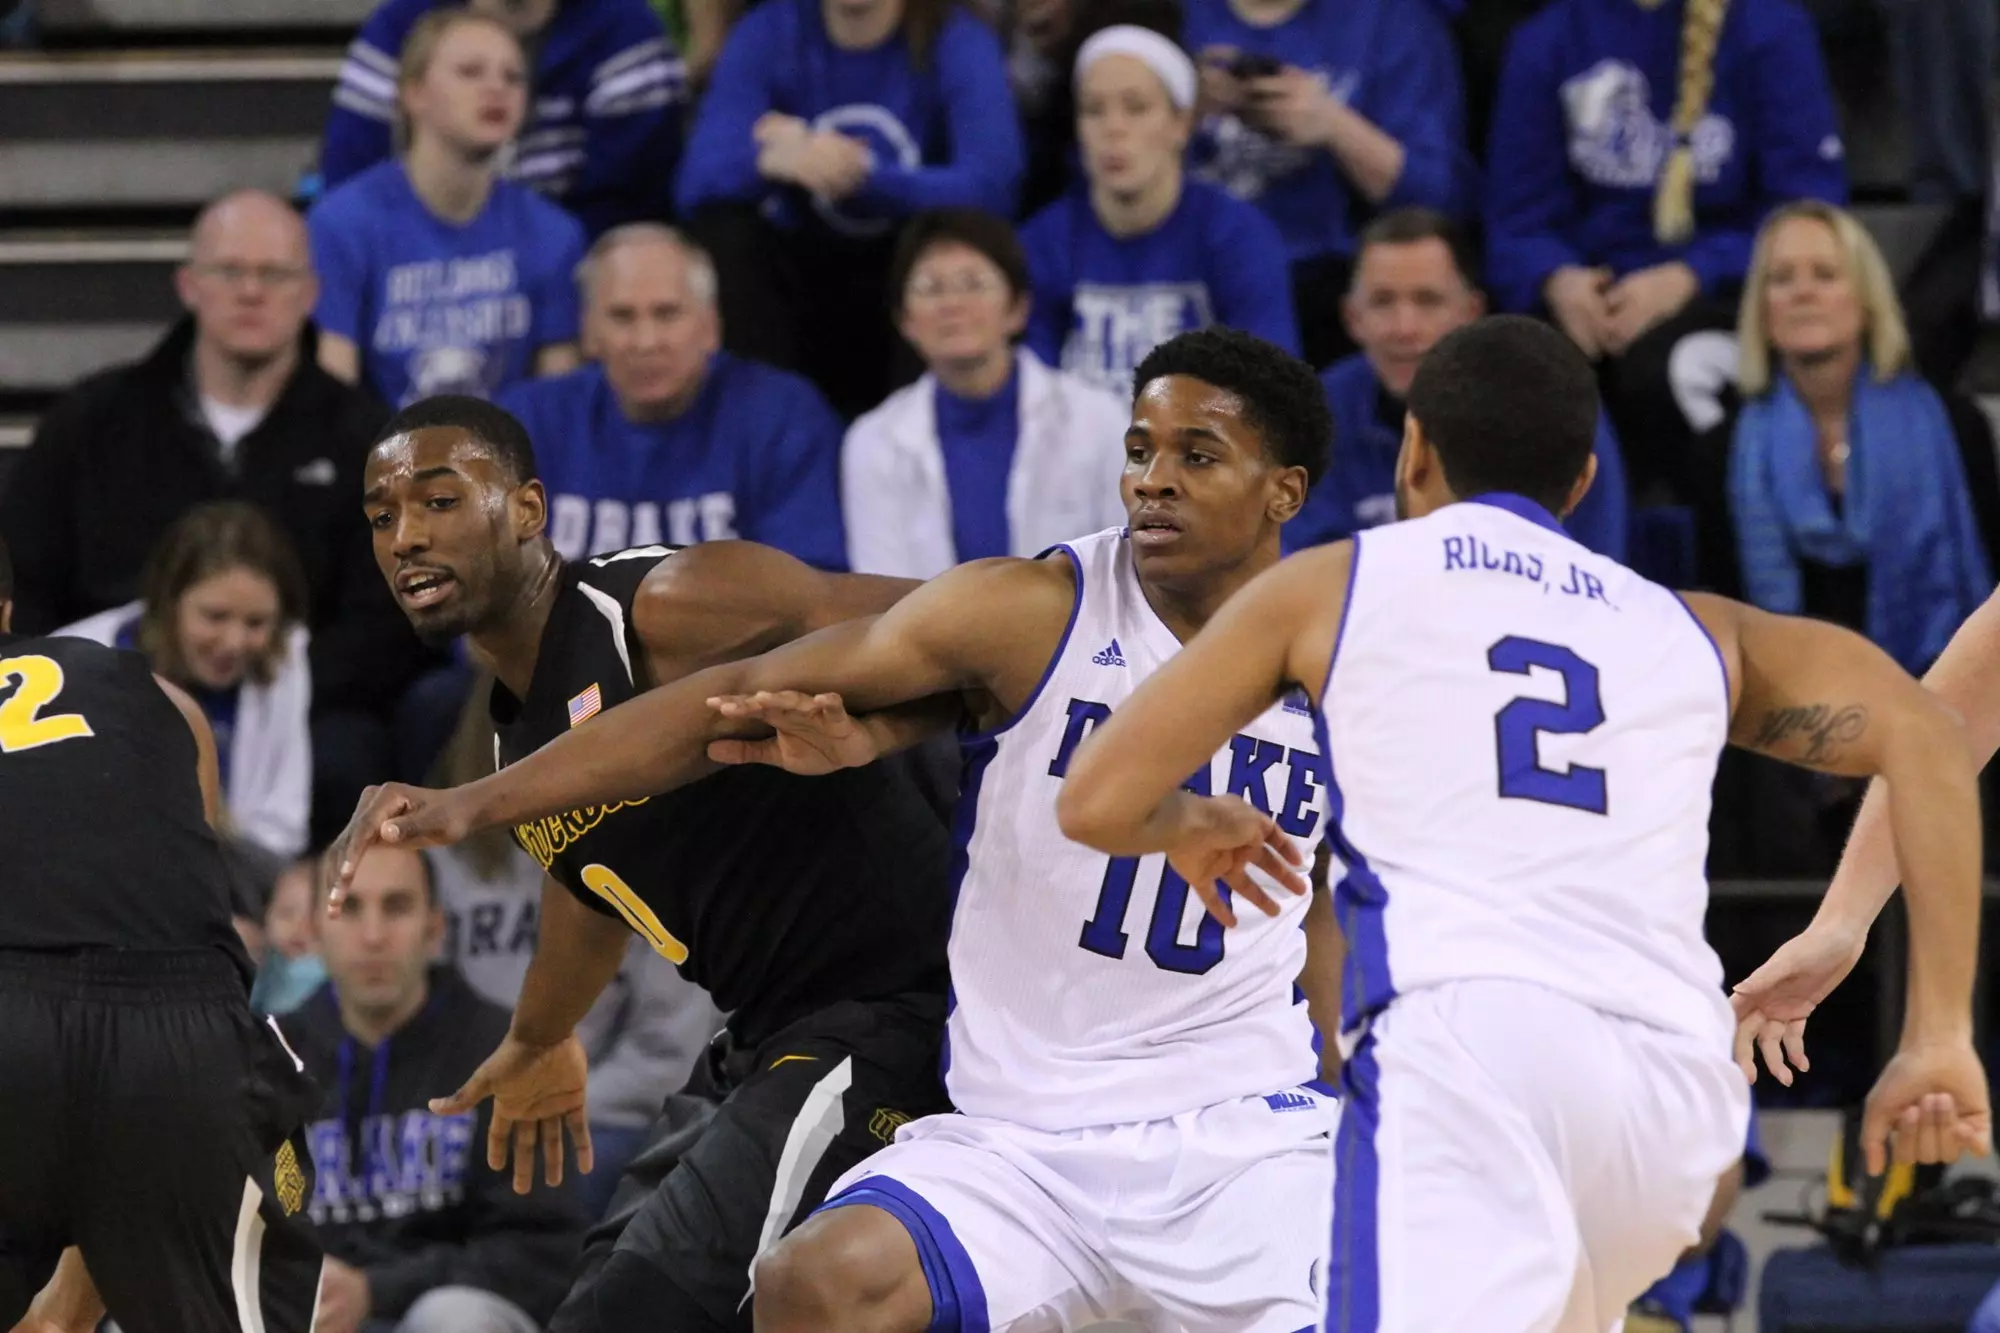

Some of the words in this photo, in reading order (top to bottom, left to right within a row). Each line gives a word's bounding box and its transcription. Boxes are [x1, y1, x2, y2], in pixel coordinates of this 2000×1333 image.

[551, 492, 741, 562] DRAKE
[1092, 655, 1127, 668] adidas
[1047, 697, 1327, 839] DKE
[1487, 634, 1608, 817] 2
[580, 863, 689, 966] 0
[1078, 855, 1233, 976] 10
